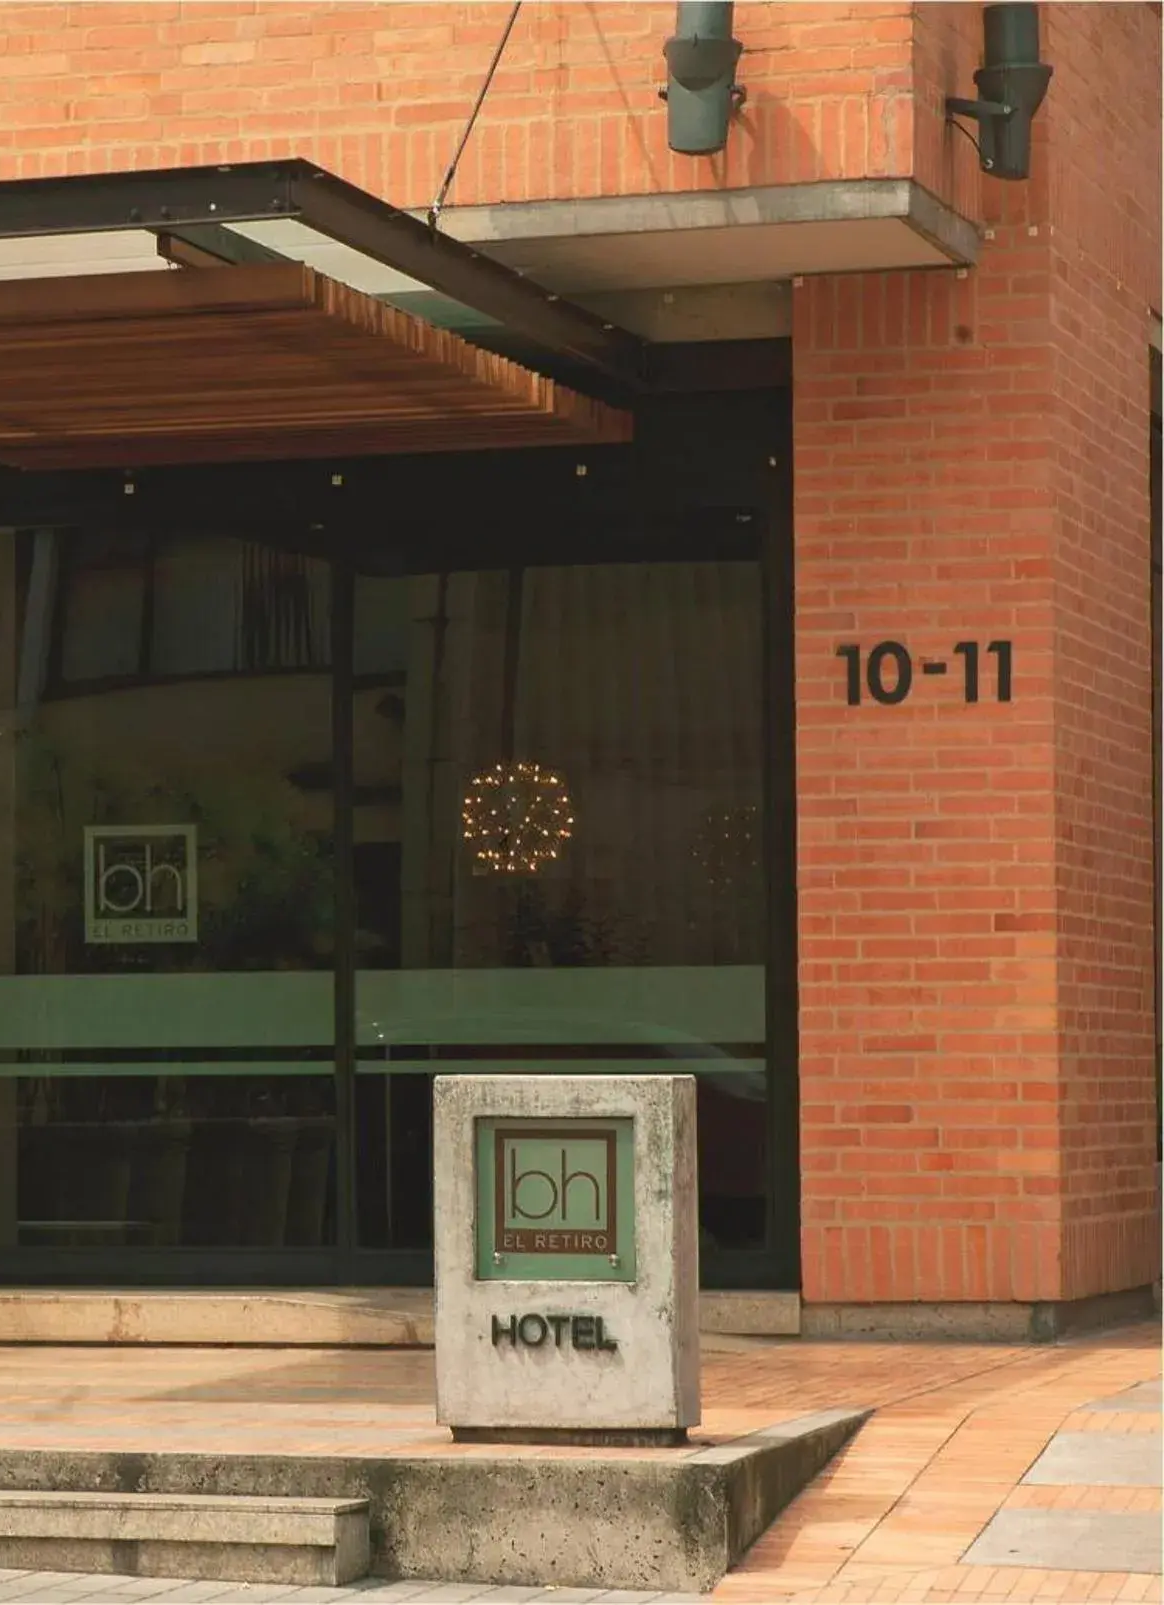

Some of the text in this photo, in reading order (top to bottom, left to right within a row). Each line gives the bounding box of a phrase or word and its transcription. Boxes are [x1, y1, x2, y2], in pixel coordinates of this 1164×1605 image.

[835, 640, 1012, 706] 10-11
[99, 843, 182, 912] bh
[92, 922, 189, 939] EL RETIRO
[511, 1148, 600, 1220] bh
[503, 1233, 609, 1249] EL RETIRO
[491, 1313, 618, 1351] HOTEL
